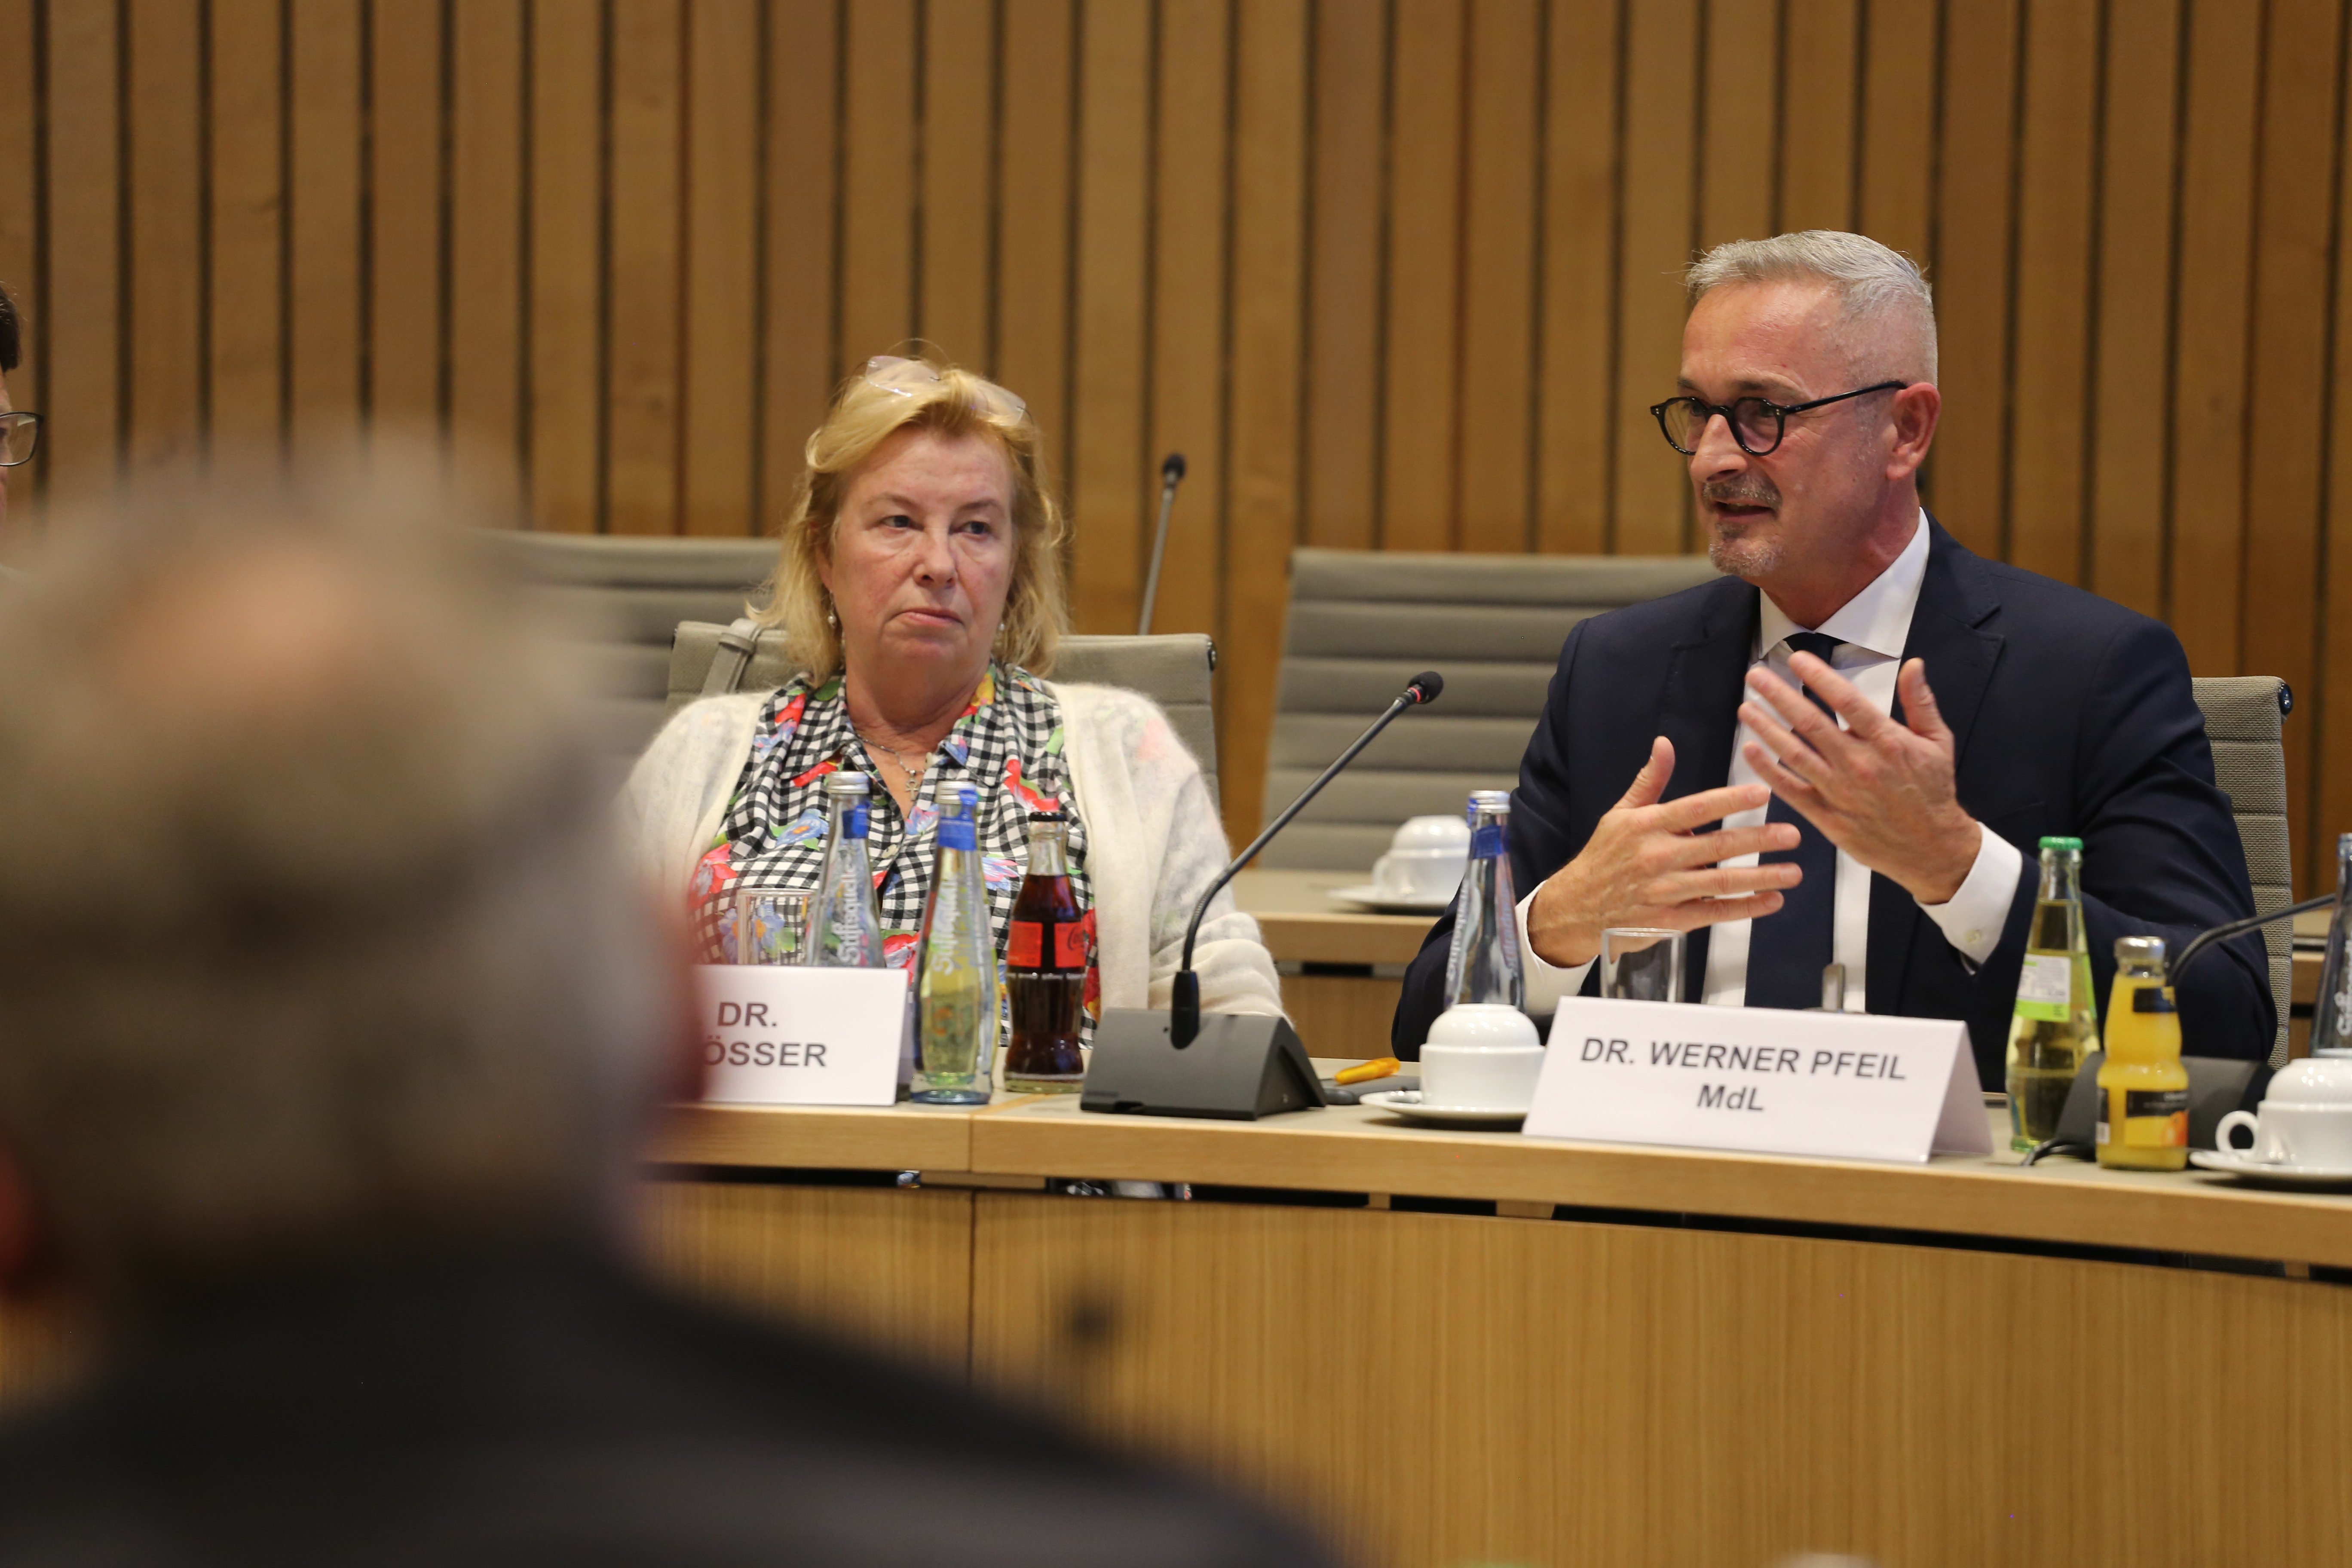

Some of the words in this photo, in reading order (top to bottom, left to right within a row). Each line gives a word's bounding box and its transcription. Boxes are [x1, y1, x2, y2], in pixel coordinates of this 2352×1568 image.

[717, 1002, 778, 1027] DR.
[1580, 1038, 1634, 1064] DR.
[1650, 1042, 1799, 1073] WERNER
[1811, 1051, 1905, 1080] PFEIL
[1697, 1084, 1764, 1110] MdL
